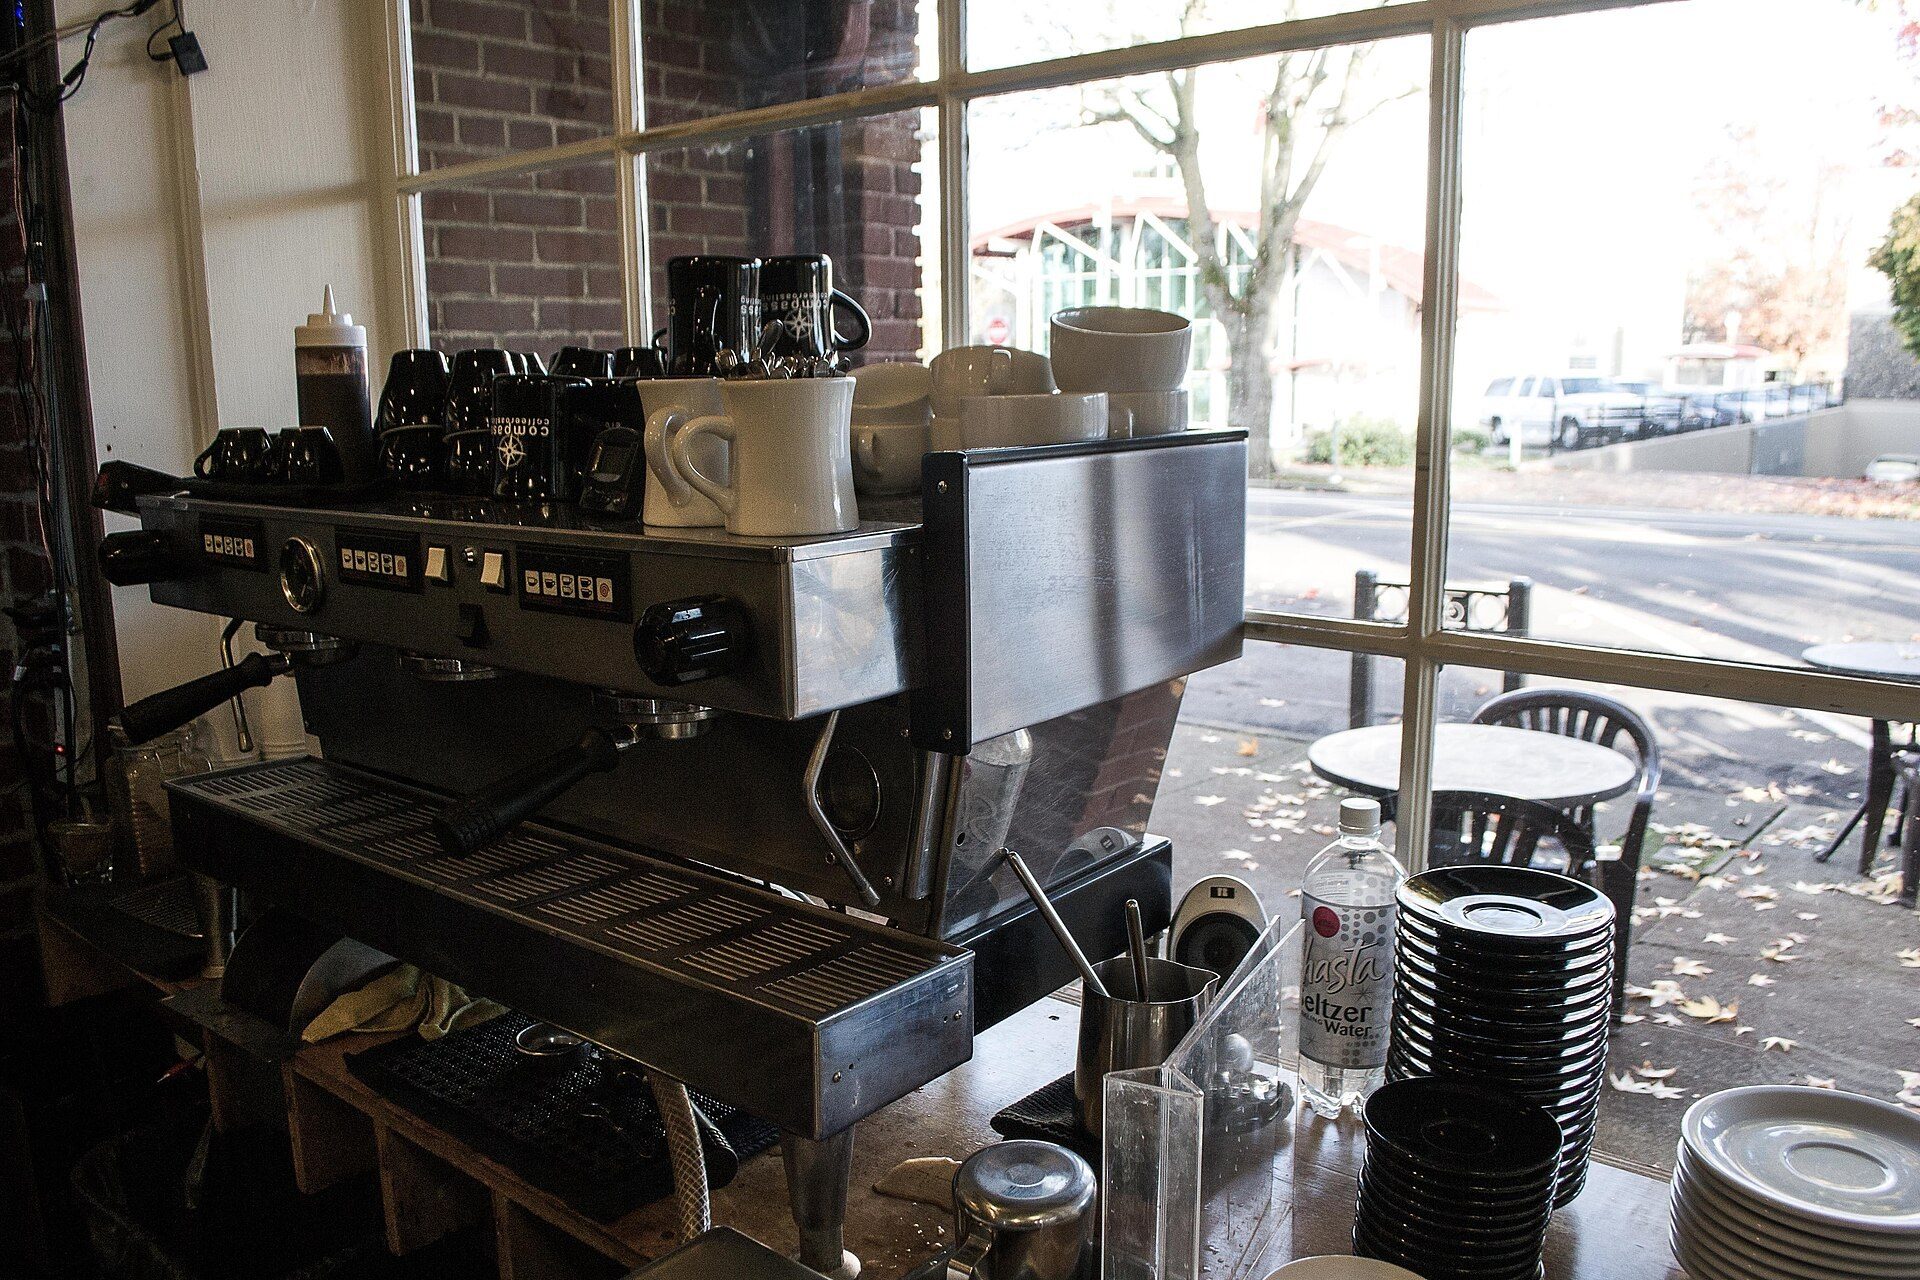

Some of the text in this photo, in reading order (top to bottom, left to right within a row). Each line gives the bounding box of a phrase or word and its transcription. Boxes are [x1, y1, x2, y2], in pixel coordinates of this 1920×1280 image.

[1304, 936, 1386, 994] hasta
[1302, 993, 1373, 1022] eltzer
[1325, 1020, 1373, 1037] Water
